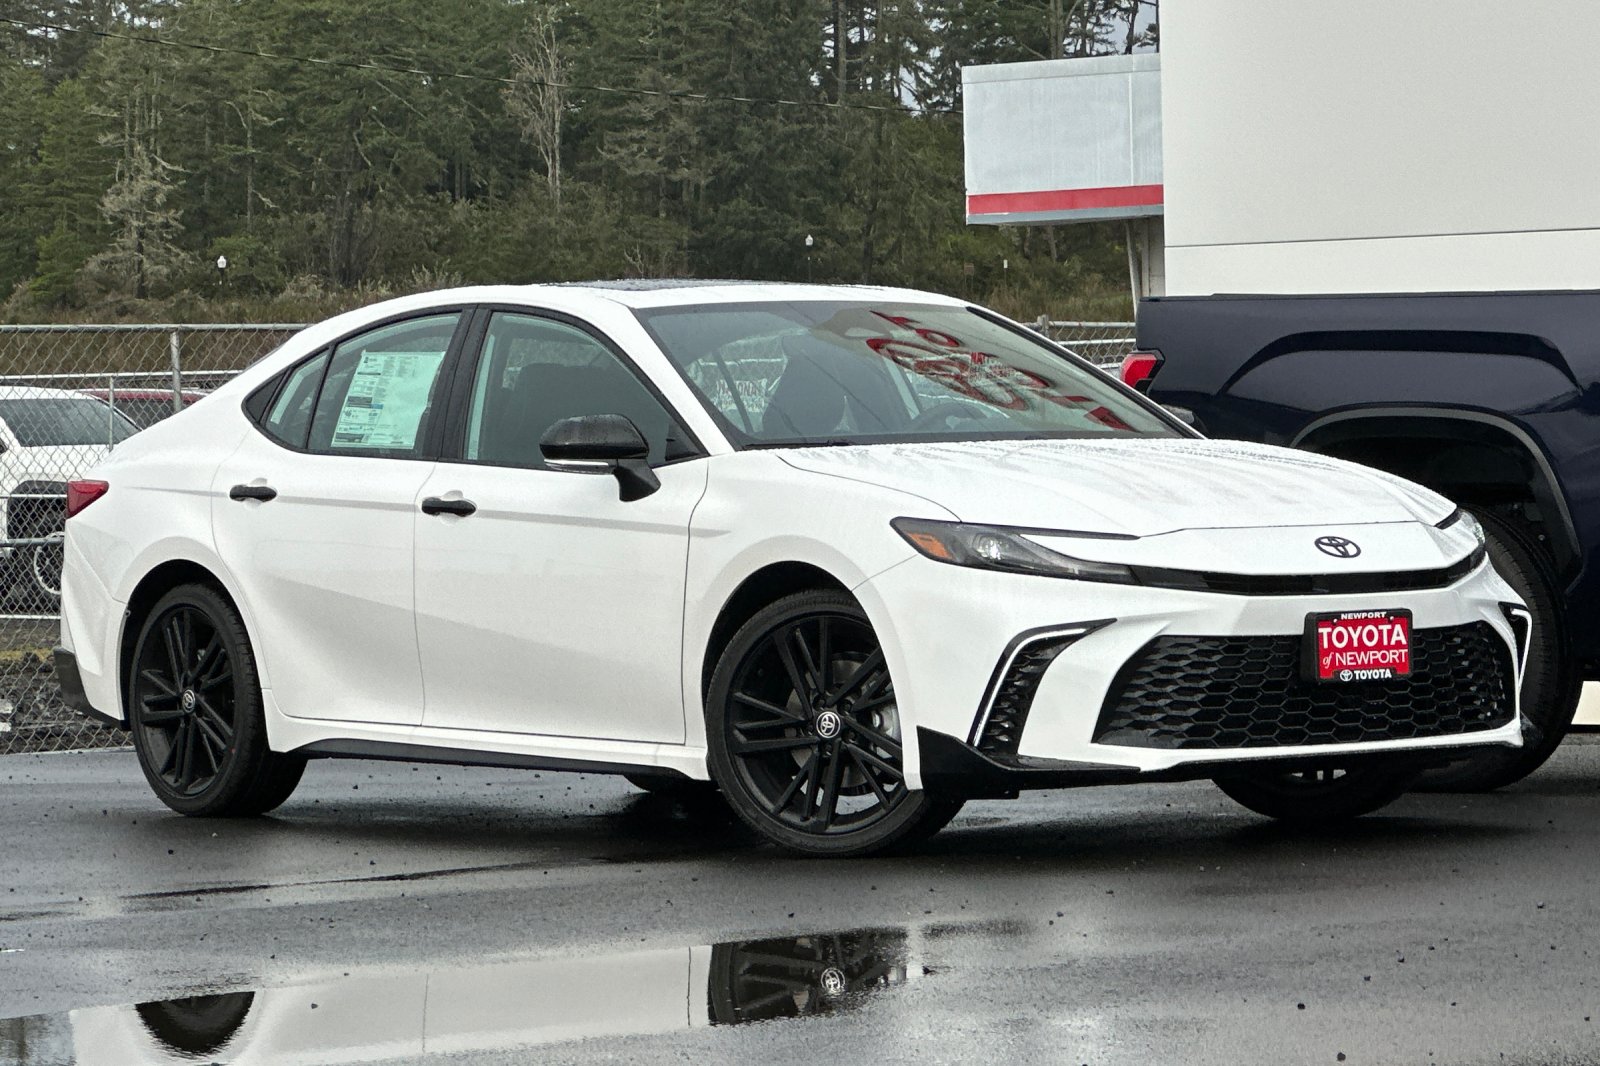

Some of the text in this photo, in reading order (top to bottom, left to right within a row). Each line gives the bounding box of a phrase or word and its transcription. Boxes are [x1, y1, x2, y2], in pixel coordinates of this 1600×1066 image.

[1341, 611, 1387, 620] NEWPORT
[1318, 624, 1407, 649] TOYOTA
[1322, 649, 1408, 669] of NEWPORT
[1353, 669, 1392, 680] TOYOTA
